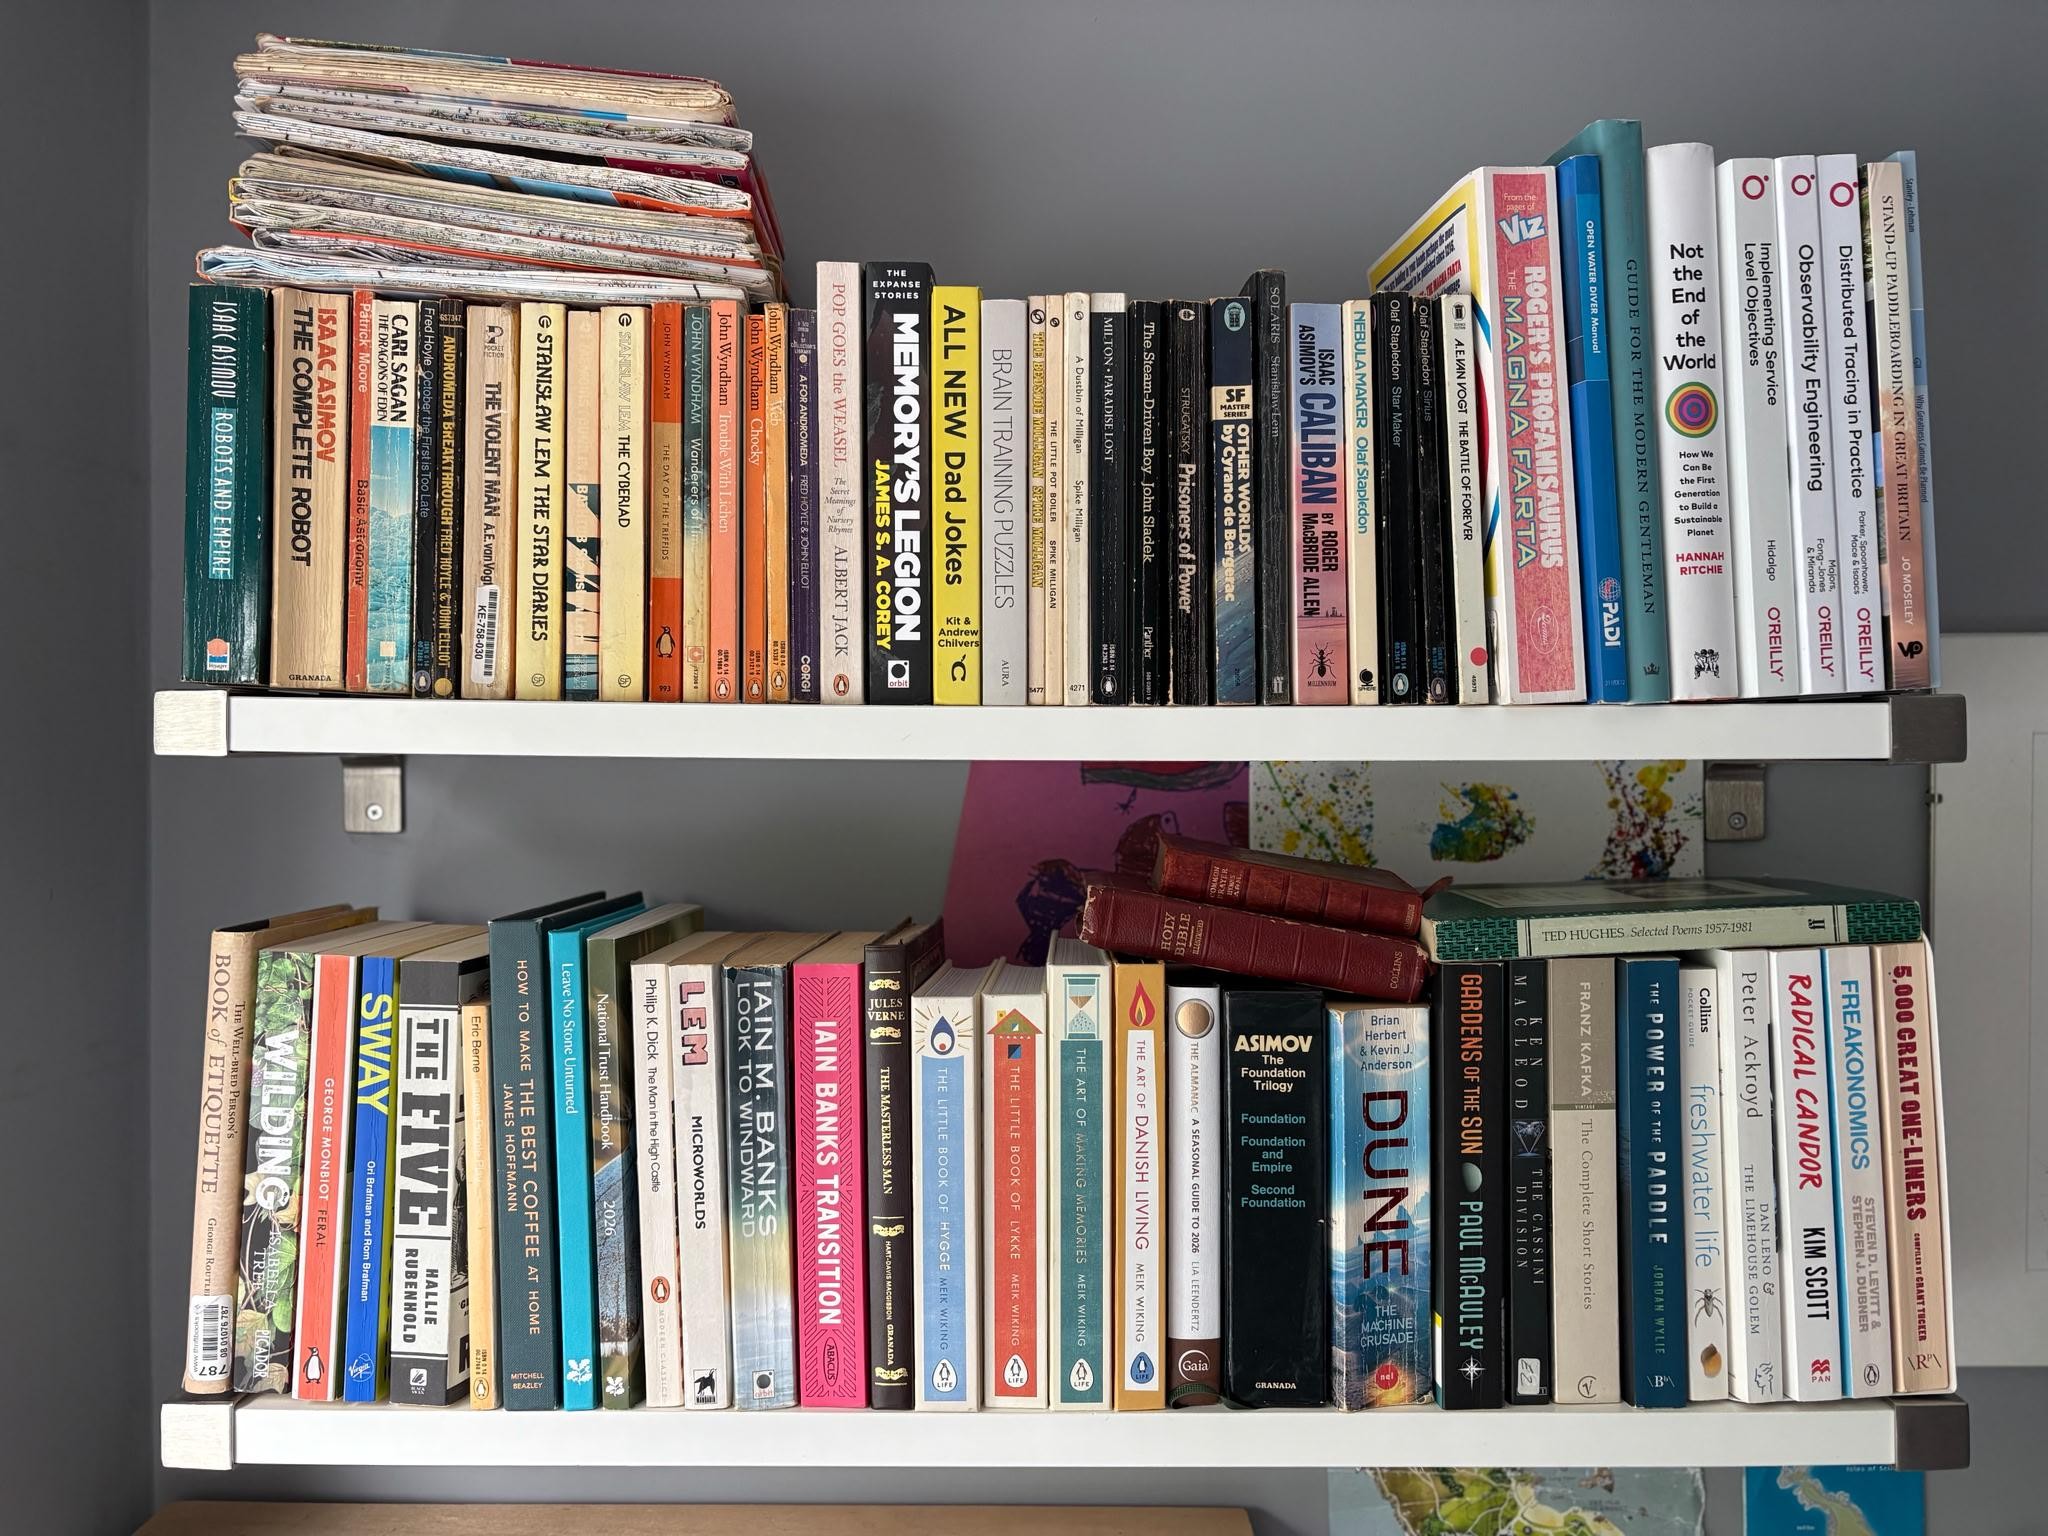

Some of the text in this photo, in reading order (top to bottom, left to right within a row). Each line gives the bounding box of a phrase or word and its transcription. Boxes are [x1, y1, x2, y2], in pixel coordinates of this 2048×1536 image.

[1669, 245, 1703, 260] Not
[1672, 288, 1706, 304] End
[357, 303, 371, 393] Patrick Moore
[390, 314, 408, 422] CARL SAGAN
[690, 313, 703, 424] JOHN WYNDHAM
[1664, 355, 1716, 371] World
[1798, 244, 1825, 492] Observability Engineering
[210, 301, 238, 577] ISAAC ASIMOV ROBOTS AND EMPIRE
[291, 307, 313, 566] THE COMPLETE ROBOT
[484, 382, 502, 517] THE VIOLENT MAN
[748, 418, 762, 465] Chocky
[944, 305, 967, 585] ALL NEW Dad Jokes
[1104, 375, 1114, 463] PARADISE LOST
[1300, 393, 1337, 504] CALIBAN
[1391, 387, 1403, 447] Star Maker
[1523, 266, 1563, 568] ROGER'S PROFANISAURUS
[617, 435, 631, 528] THE CYBERIAD
[893, 314, 920, 641] MEMORY'S LEGION
[992, 349, 1014, 609] BRAIN TRAINING PUZZLES
[1072, 480, 1084, 543] Spike Milligan
[1141, 482, 1155, 562] John Sladek
[1237, 424, 1251, 552] OTHER WORLDS
[1458, 420, 1473, 540] THE BATTLE OF FOREVER
[1634, 413, 1655, 614] MODERN GENTLEMAN
[531, 484, 550, 641] THE STAR DIARIES
[875, 459, 891, 649] JAMES S. A. COREY
[1178, 463, 1196, 613] Prisoners of Power
[1676, 553, 1724, 562] HANNAH
[1680, 566, 1723, 576] RITCHIE
[1766, 540, 1778, 581] Hidalgo
[474, 605, 487, 660] KE-758-030
[833, 545, 848, 657] ALBERT JACK
[1602, 602, 1620, 647] PADI
[1900, 556, 1915, 625] JO MOSELEY
[800, 655, 811, 692] CORGI
[1001, 660, 1010, 686] AURA
[1160, 912, 1175, 951] HOLY
[1174, 913, 1191, 957] BIBLE
[1390, 951, 1403, 989] COLLINS
[1542, 921, 1753, 942] TED HUGHES Selected Poems 1957-1981
[357, 993, 393, 1115] SWAY
[470, 1016, 481, 1035] Eric
[471, 1039, 482, 1073] Berne
[560, 963, 578, 1114] Leave No Stone Unturned
[642, 979, 660, 1059] Philip K. Dick
[680, 981, 708, 1066] LEM
[1234, 1035, 1313, 1053] ASIMOV
[1579, 982, 1593, 1097] FRANZ KAFKA
[1698, 988, 1712, 1033] Collins
[1741, 971, 1763, 1119] Peter Ackroyd
[201, 954, 231, 1193] BOOK of ETIQUETTE
[753, 981, 776, 1237] IAIN M. BANKS
[1253, 1080, 1294, 1092] Trilogy
[1360, 1062, 1412, 1071] Anderson
[1460, 974, 1483, 1154] GARDENS OF THE SUN
[1788, 973, 1823, 1190] RADICAL CANDOR
[1839, 980, 1870, 1170] FREAKONOMICS
[256, 1030, 299, 1211] WILDING
[319, 1078, 335, 1201] GEORGE MONBIOT
[398, 1019, 450, 1227] THE FIVE
[502, 1083, 519, 1212] JAMES HOFFMANN
[879, 1067, 893, 1194] THE MASTERLESS MAN
[1897, 1027, 1926, 1220] GREAT ONE-LINERS
[519, 1079, 539, 1258] THE BEST COFFEE
[691, 1116, 706, 1229] MICROWORLDS
[1134, 1115, 1150, 1251] DANISH LIVING
[1361, 1091, 1409, 1279] DUNE
[1647, 1152, 1667, 1243] PADDLE
[1689, 1084, 1719, 1268] freshwater life
[603, 1200, 617, 1236] 2026
[817, 1175, 841, 1324] TRANSITION
[937, 1222, 951, 1271] HYGGE
[1008, 1220, 1022, 1260] LYKKE
[402, 1248, 419, 1343] RUBENHOLD
[422, 1268, 439, 1325] HALLIE
[1076, 1274, 1088, 1347] MEIK WIKING
[1802, 1227, 1830, 1320] KIM SCOTT
[197, 1365, 228, 1376] 787
[253, 1329, 268, 1378] PICADOR
